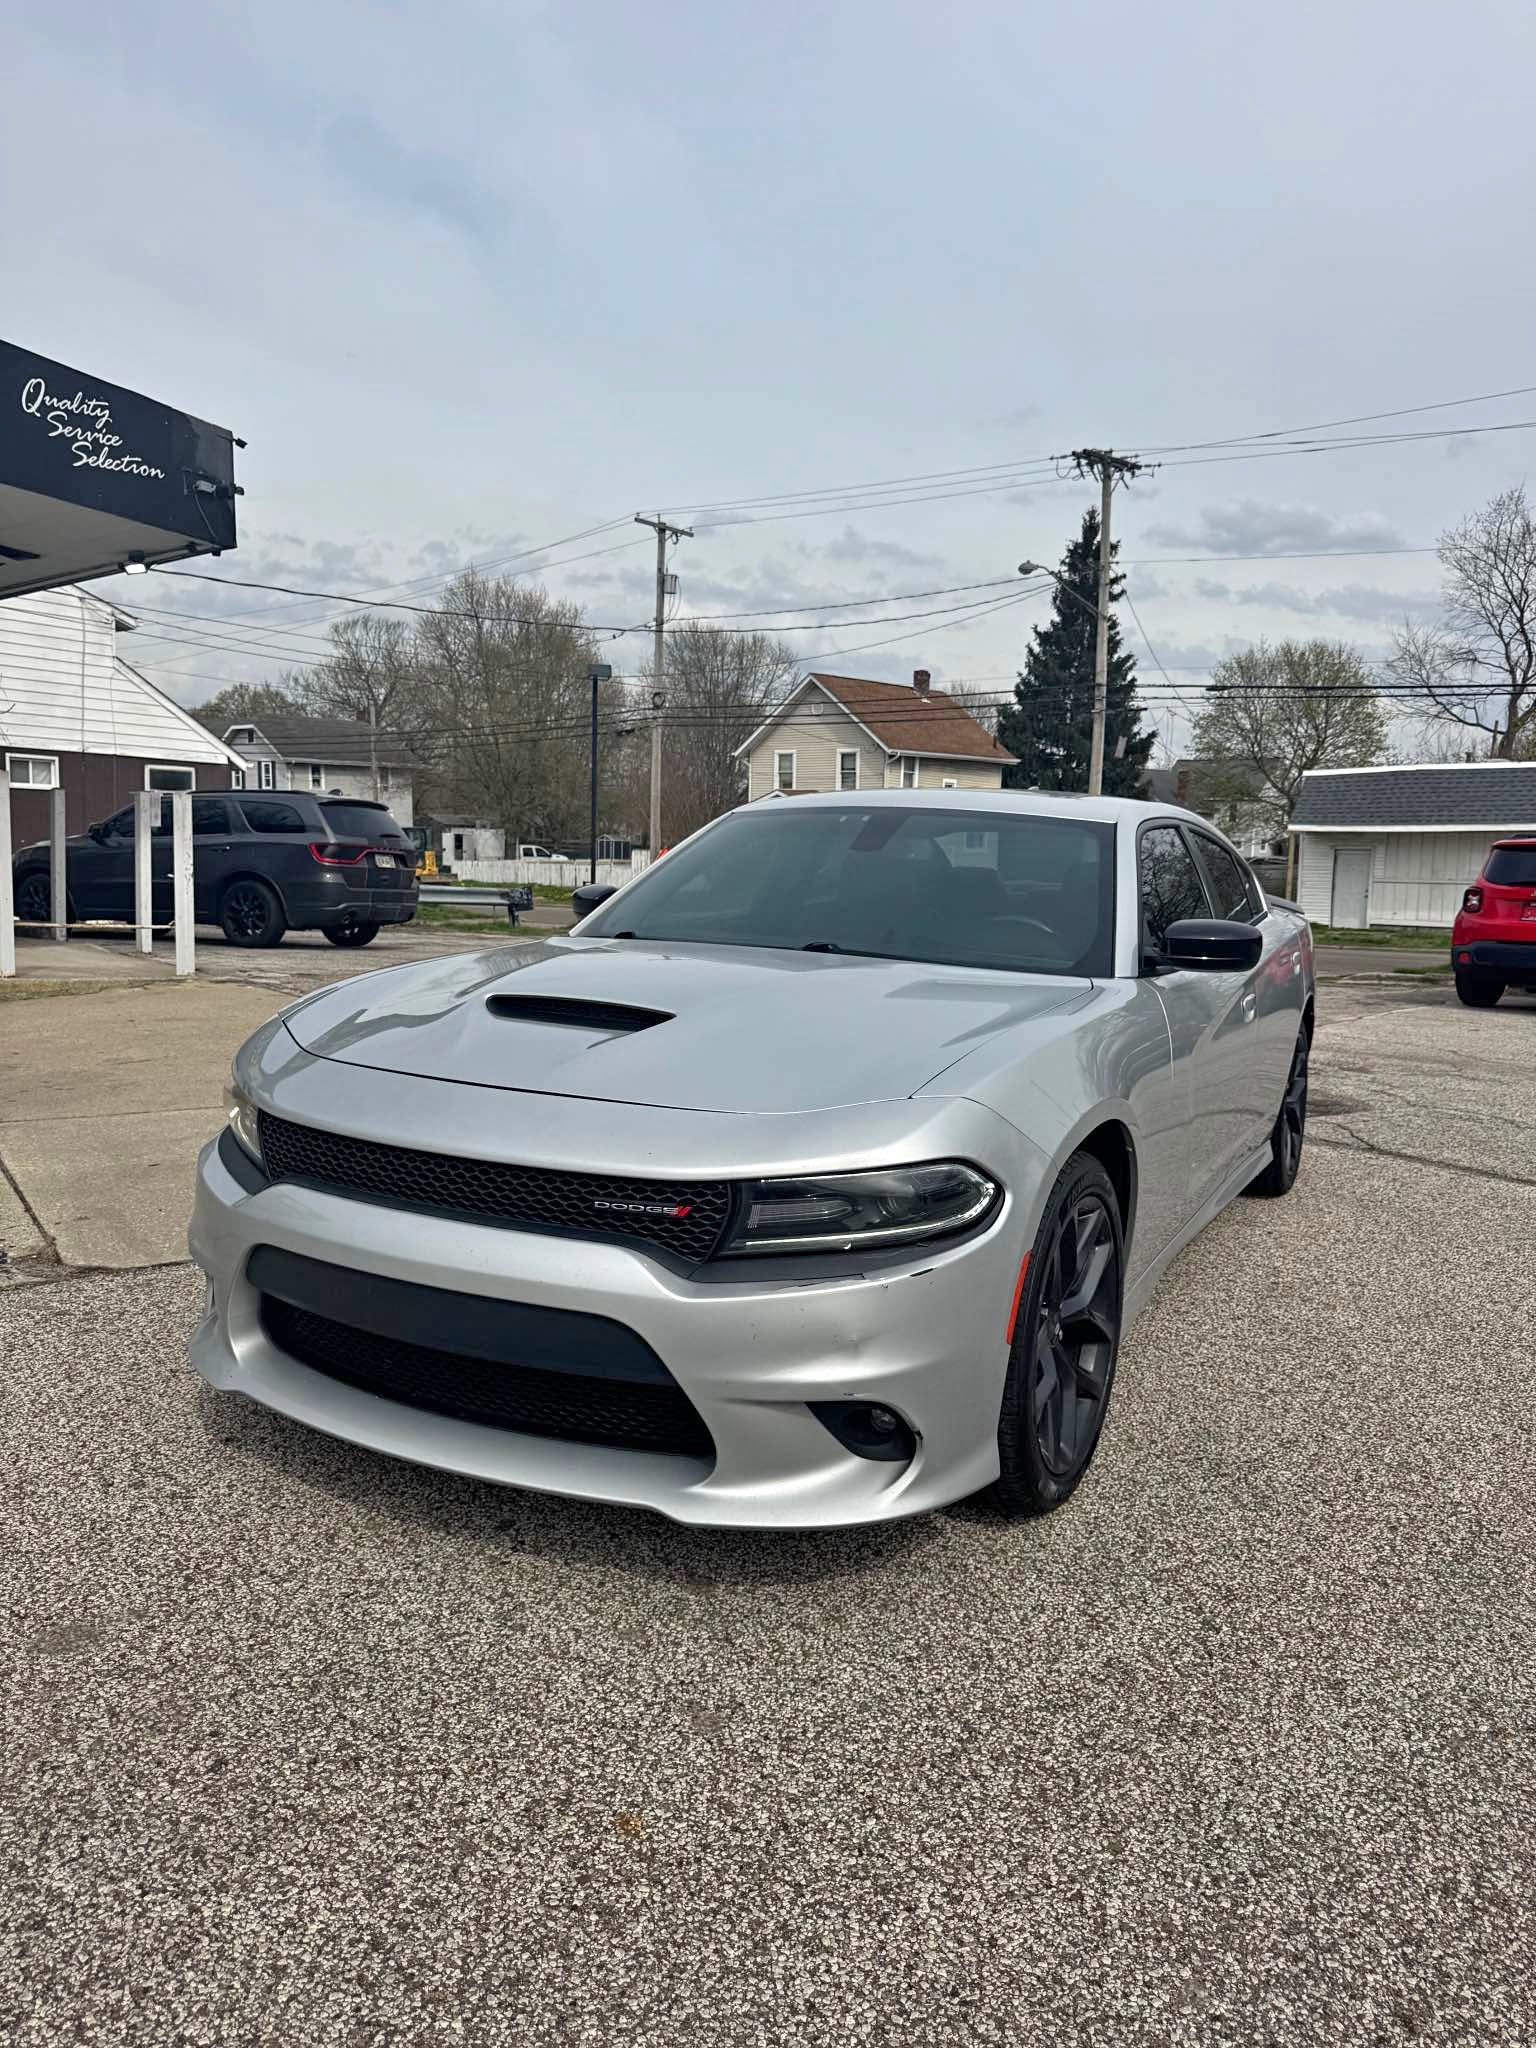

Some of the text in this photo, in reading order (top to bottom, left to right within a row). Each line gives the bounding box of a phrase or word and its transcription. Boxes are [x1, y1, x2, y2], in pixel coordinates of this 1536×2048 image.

[21, 378, 113, 429] Quality
[46, 410, 123, 446] Service
[71, 441, 165, 479] Selection
[594, 1201, 679, 1215] DODGE
